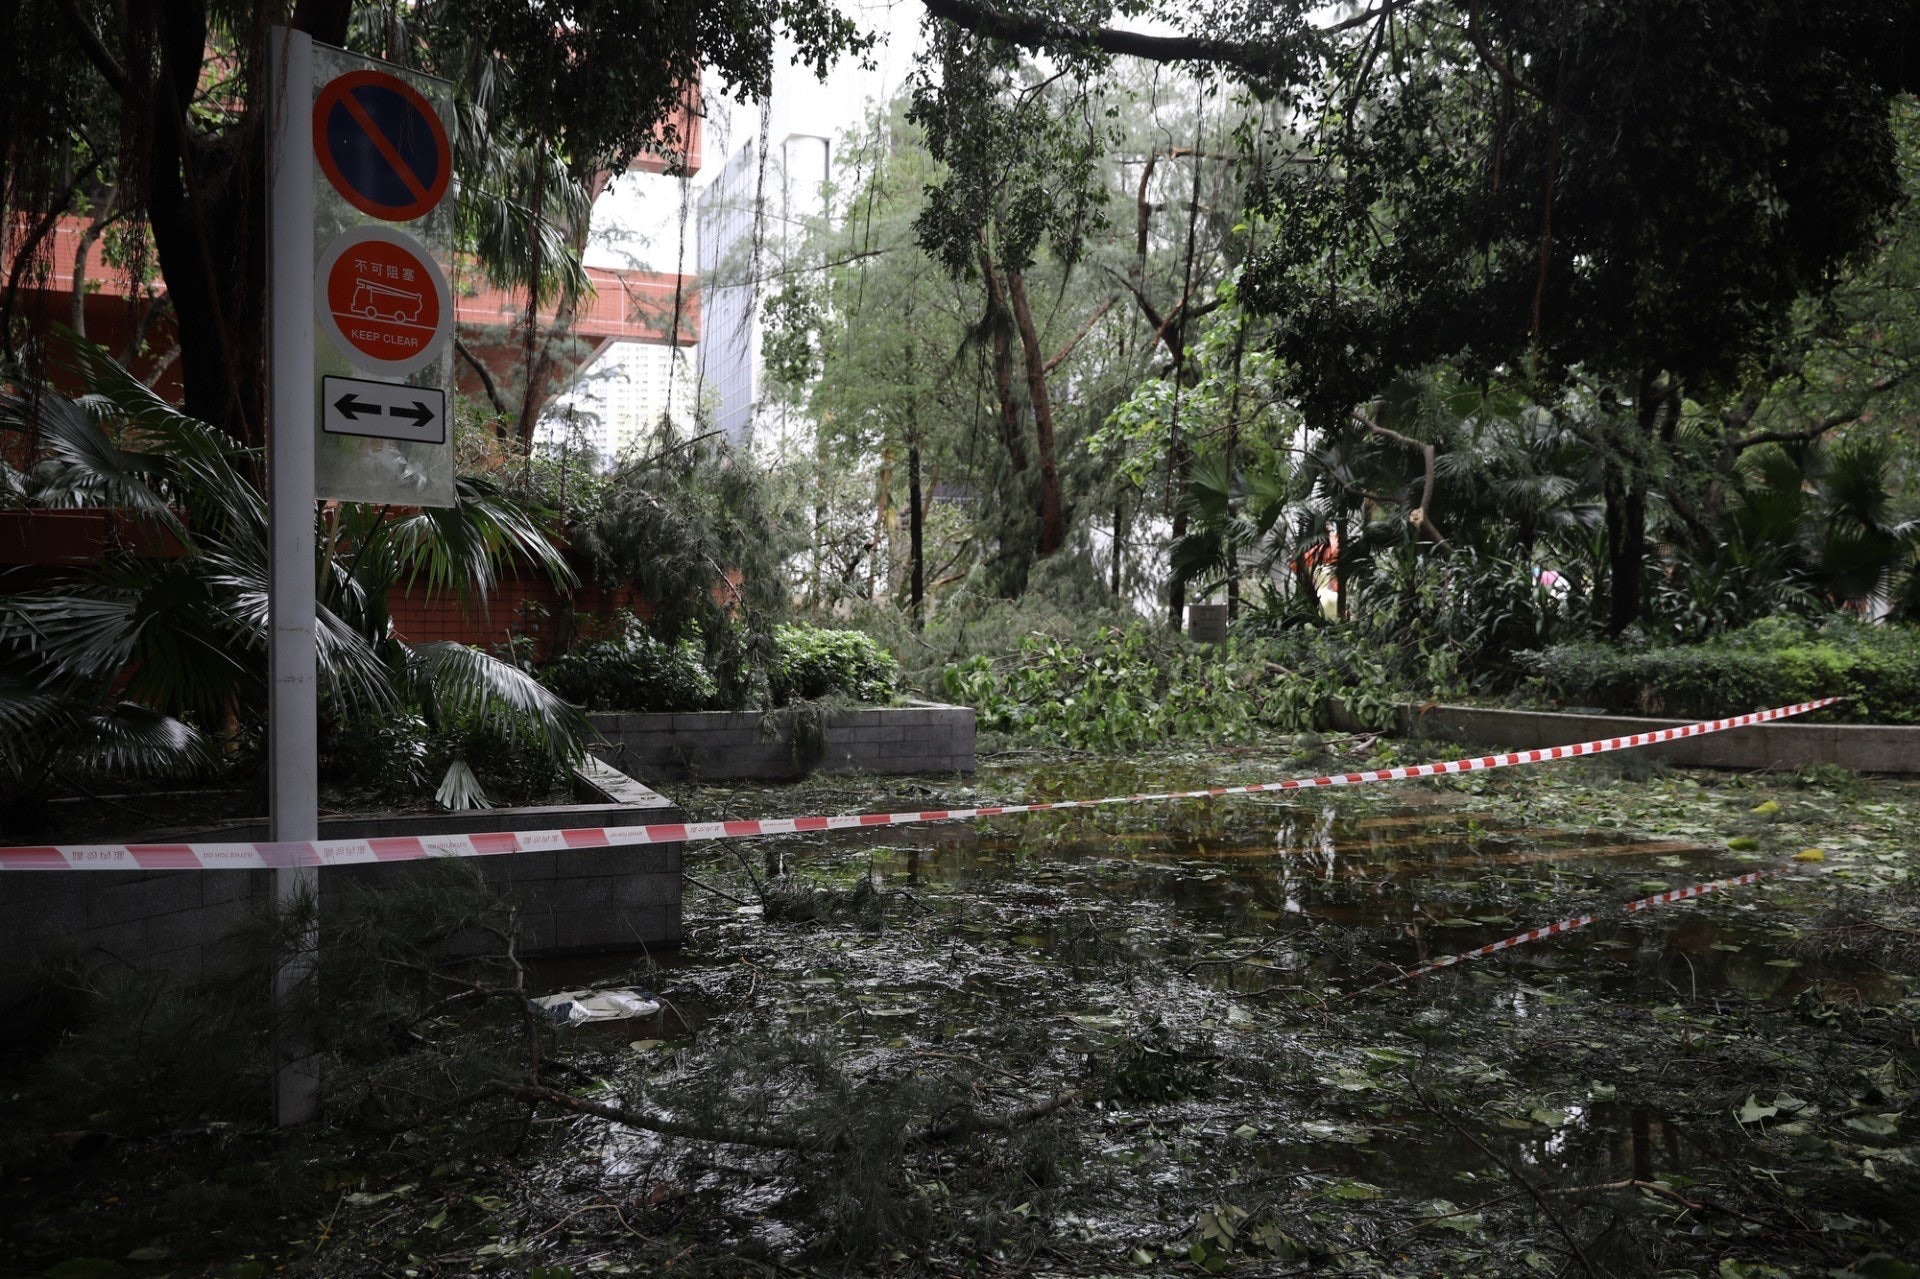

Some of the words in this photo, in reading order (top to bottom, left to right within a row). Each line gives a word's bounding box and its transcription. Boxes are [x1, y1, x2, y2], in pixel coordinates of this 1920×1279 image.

[354, 259, 415, 282] 不可阻塞
[351, 329, 381, 342] KEEP
[383, 333, 418, 347] CLEAR
